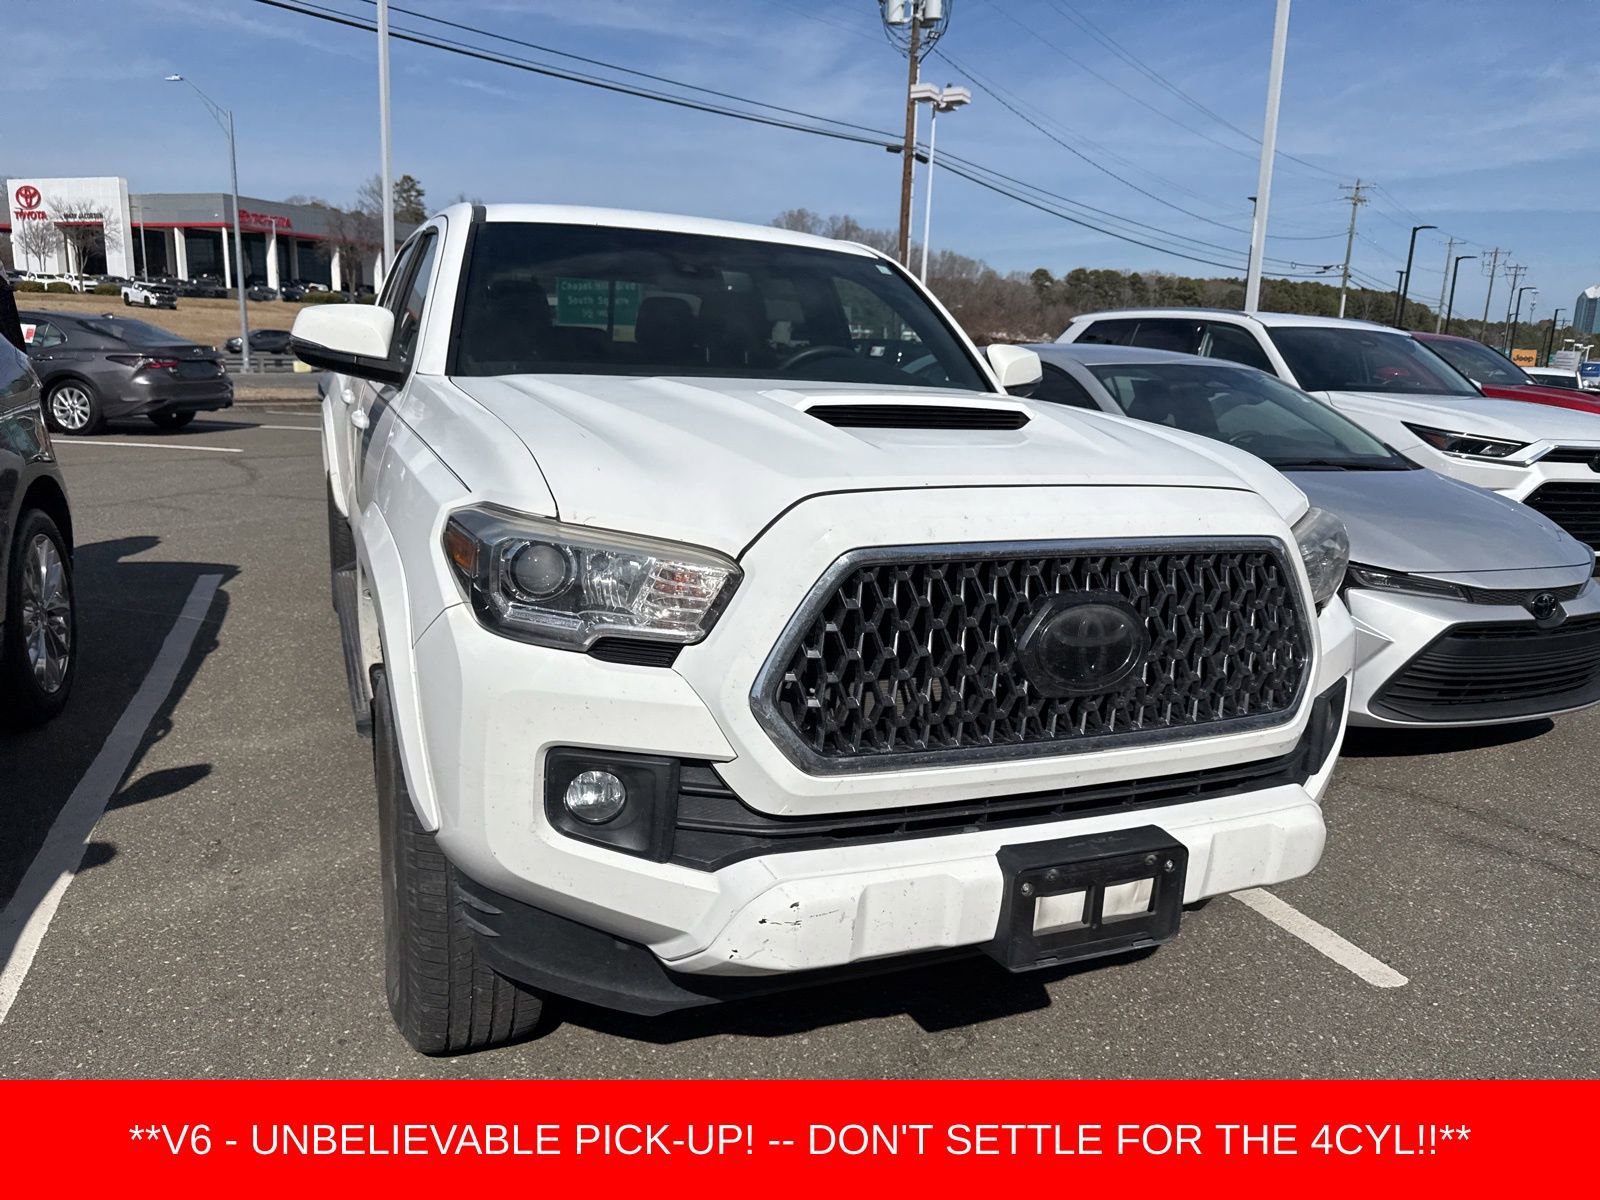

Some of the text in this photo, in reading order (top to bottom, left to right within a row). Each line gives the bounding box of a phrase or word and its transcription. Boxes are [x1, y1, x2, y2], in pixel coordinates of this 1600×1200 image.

[15, 210, 48, 221] TOYOTA
[567, 296, 630, 307] South Sqare
[1513, 355, 1534, 363] Jeep
